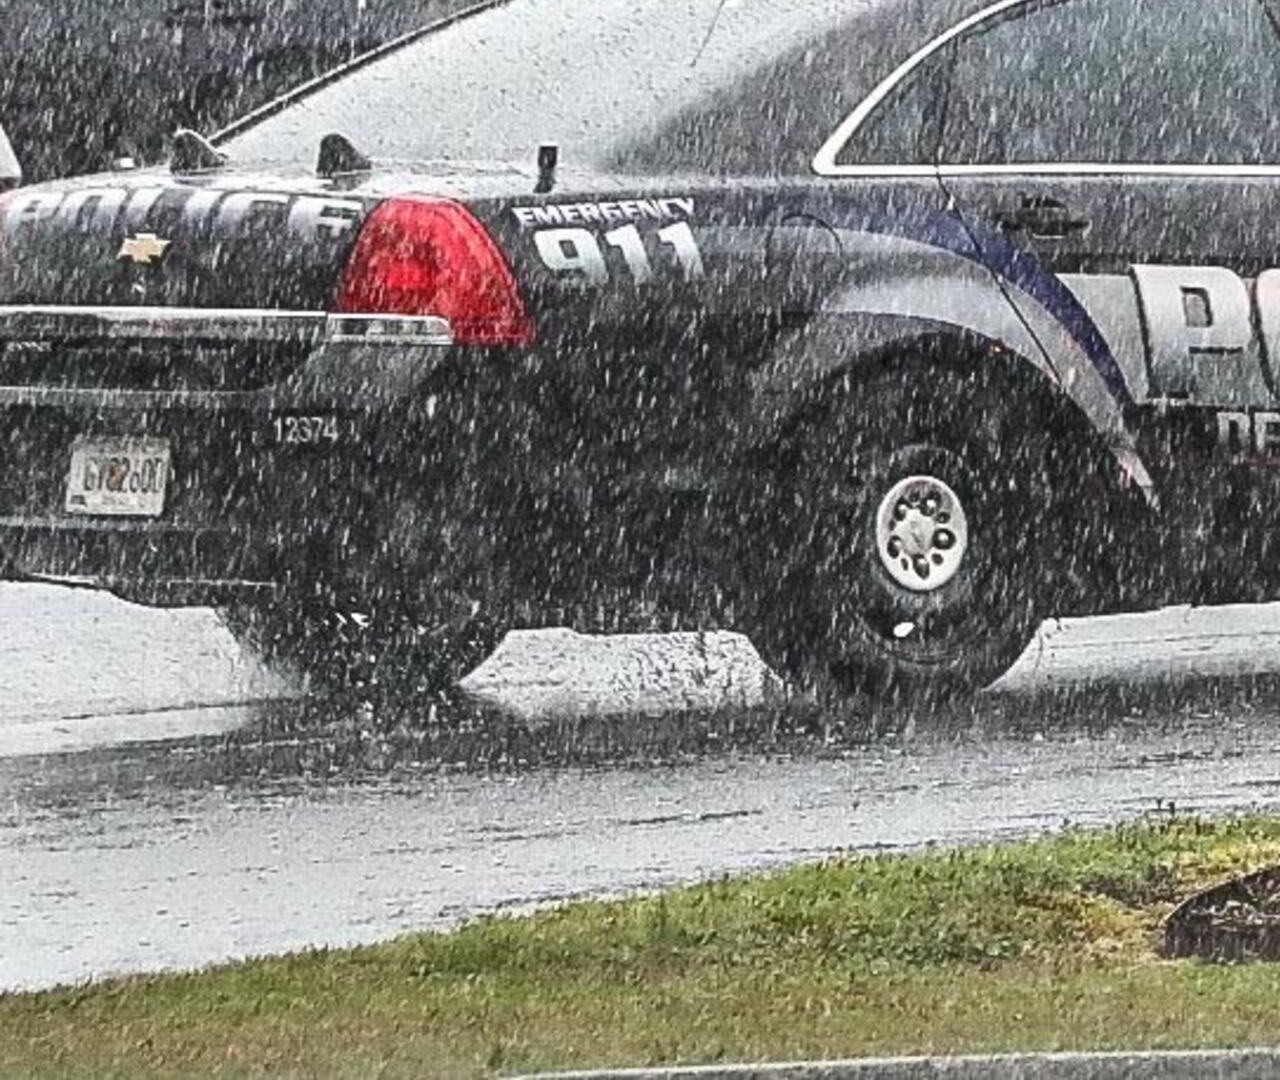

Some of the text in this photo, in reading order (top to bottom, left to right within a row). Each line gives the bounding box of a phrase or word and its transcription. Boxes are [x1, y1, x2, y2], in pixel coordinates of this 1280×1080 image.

[511, 197, 695, 227] EMERGENCY
[533, 221, 705, 283] 911
[272, 416, 339, 444] 12374
